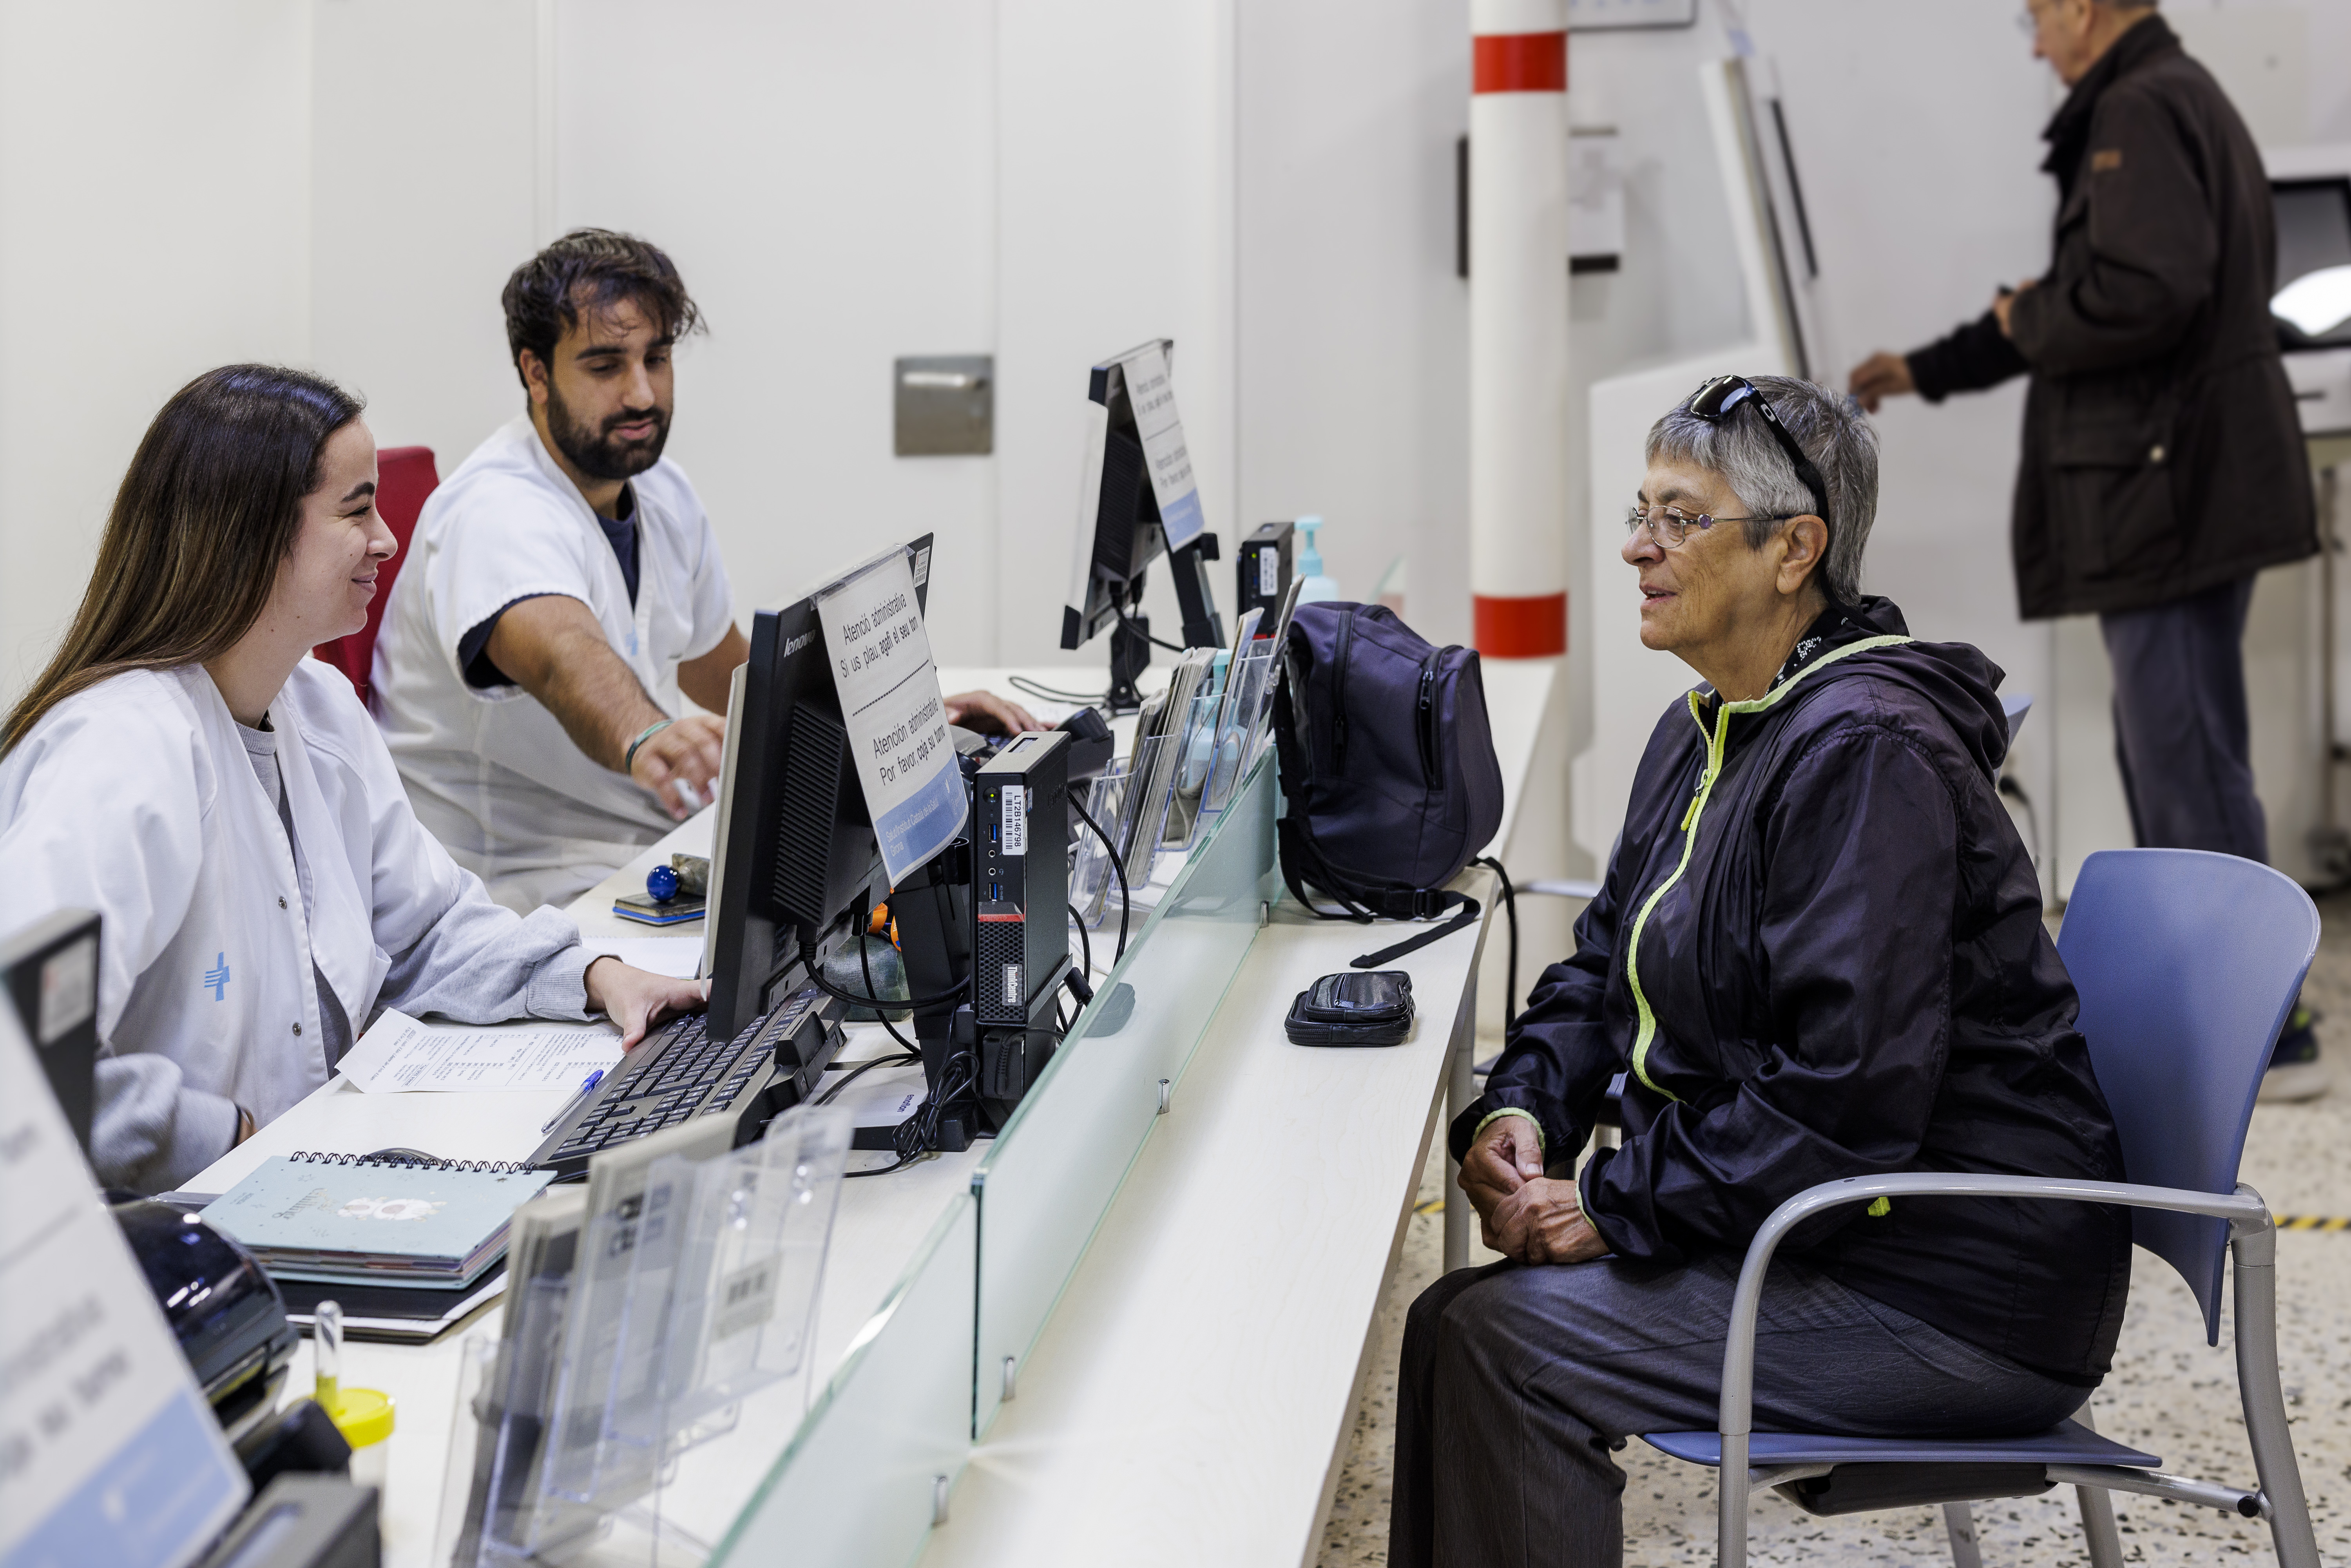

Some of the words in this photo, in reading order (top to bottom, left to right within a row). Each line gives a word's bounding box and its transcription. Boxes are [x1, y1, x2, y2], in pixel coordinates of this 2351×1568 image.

[784, 629, 815, 658] lenovo
[840, 659, 849, 678] Si
[851, 656, 861, 672] us
[863, 645, 881, 669] plau,
[879, 631, 893, 657] agafi
[893, 626, 900, 644] el
[900, 623, 910, 639] seu
[908, 616, 918, 632] torn
[843, 613, 871, 645] Atenció
[871, 592, 907, 627] administrativa
[873, 723, 908, 759] Atención
[909, 697, 938, 734] administrativa
[880, 766, 896, 786] Por
[898, 751, 919, 774] favor,
[917, 739, 929, 761] coja
[928, 735, 936, 750] su
[934, 724, 945, 744] turno
[1007, 966, 1018, 1003] ThinkCentre
